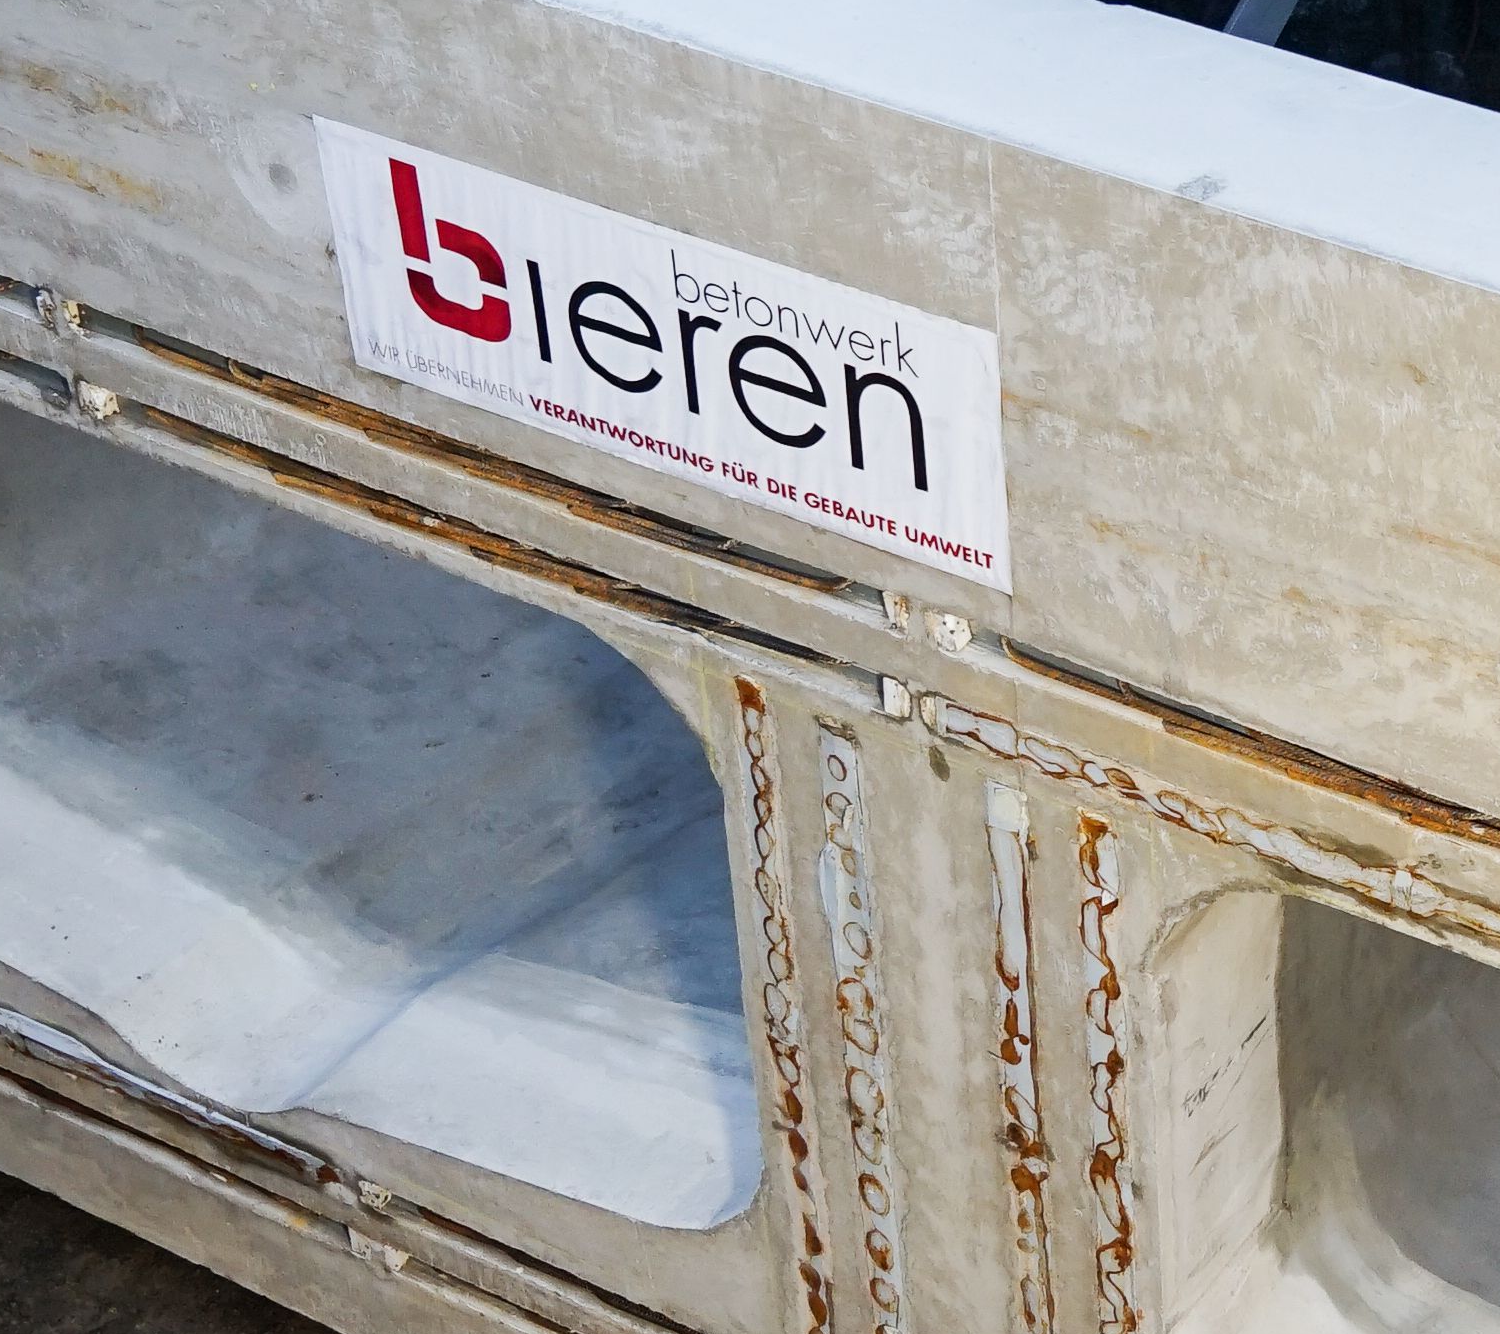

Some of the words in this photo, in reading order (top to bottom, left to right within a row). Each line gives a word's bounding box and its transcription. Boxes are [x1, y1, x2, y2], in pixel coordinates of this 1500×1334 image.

[671, 249, 919, 378] betonwerk
[368, 339, 400, 363] WIR
[406, 349, 524, 406] ÜBERNEHMEN
[529, 394, 714, 473] VERANTWORTUNG
[721, 461, 760, 489] FÜR
[767, 477, 797, 502] DIE
[804, 492, 897, 536] GEBAUTE
[904, 525, 993, 569] UMWELT
